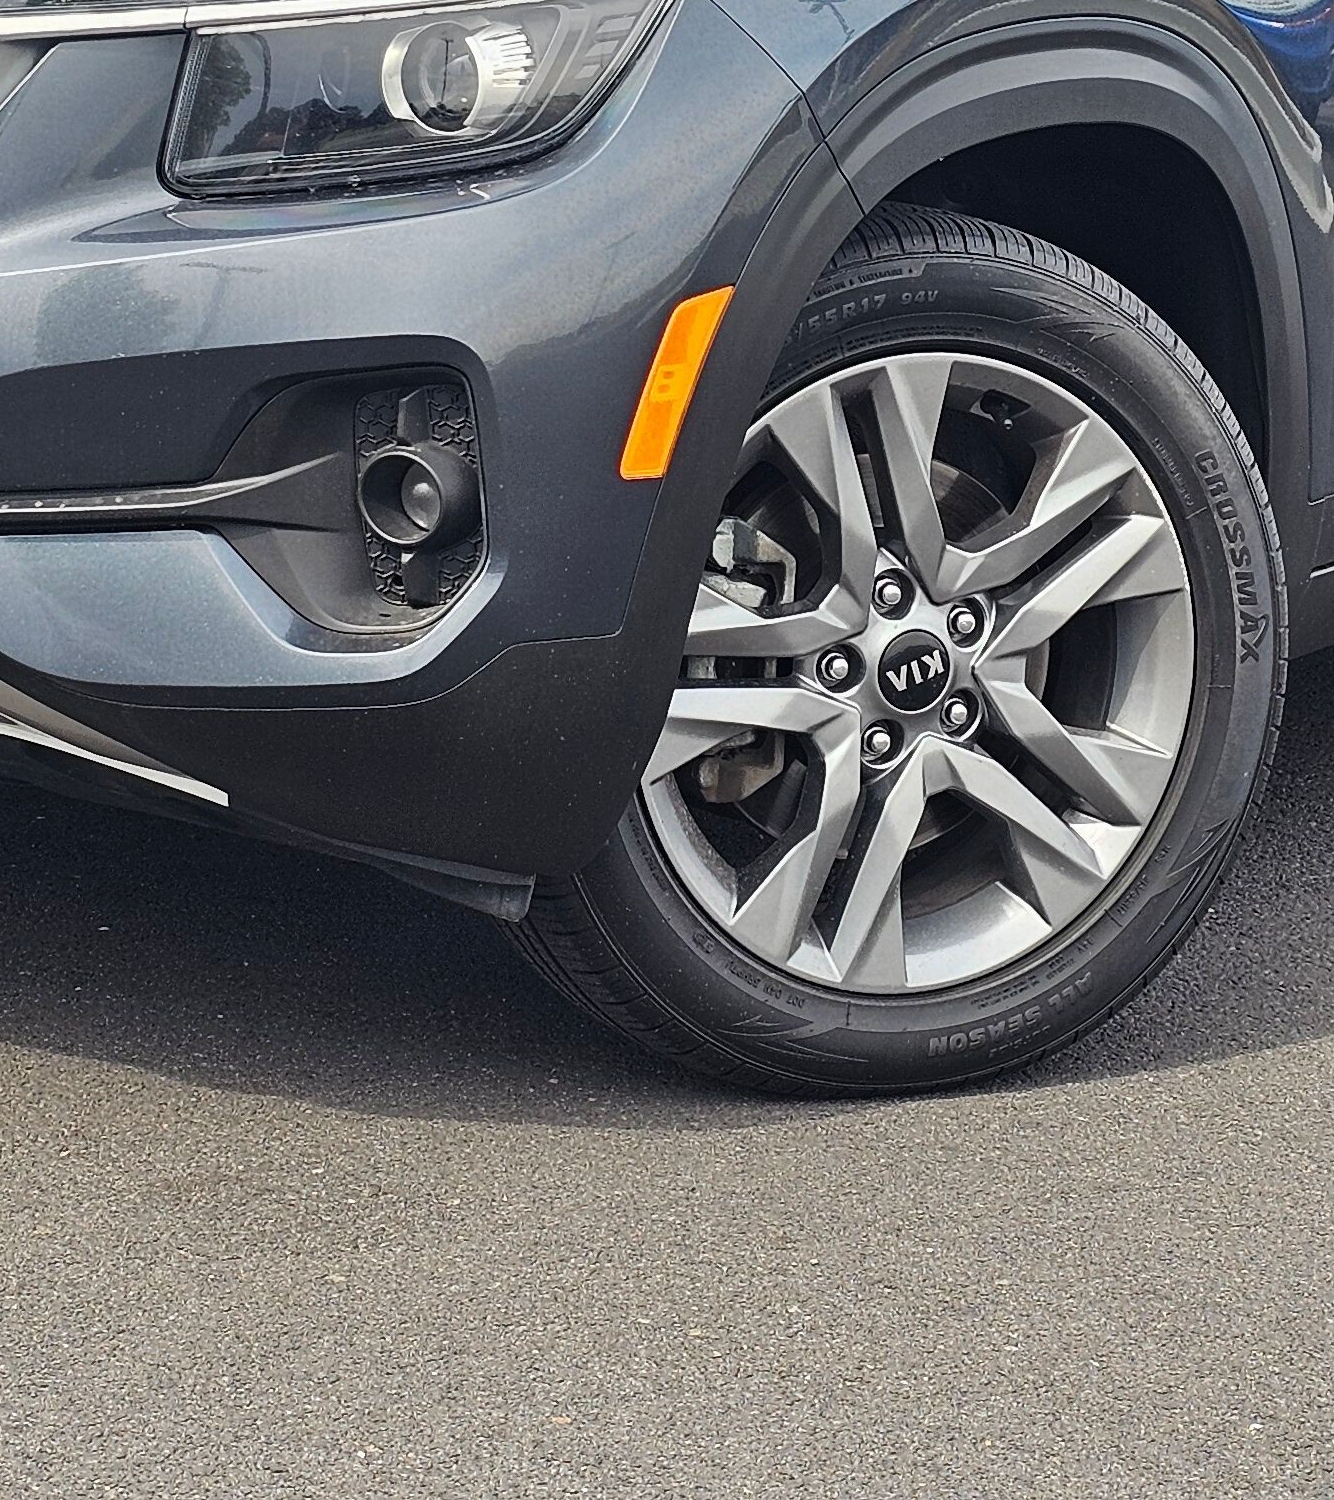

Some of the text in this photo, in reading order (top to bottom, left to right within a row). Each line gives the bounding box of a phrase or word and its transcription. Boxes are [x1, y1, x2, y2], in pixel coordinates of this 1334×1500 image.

[900, 290, 939, 306] 94V
[1194, 448, 1270, 664] CROSSMAX
[885, 649, 946, 692] KIA
[1048, 971, 1092, 1013] ALL
[928, 1005, 1043, 1057] SEASON
